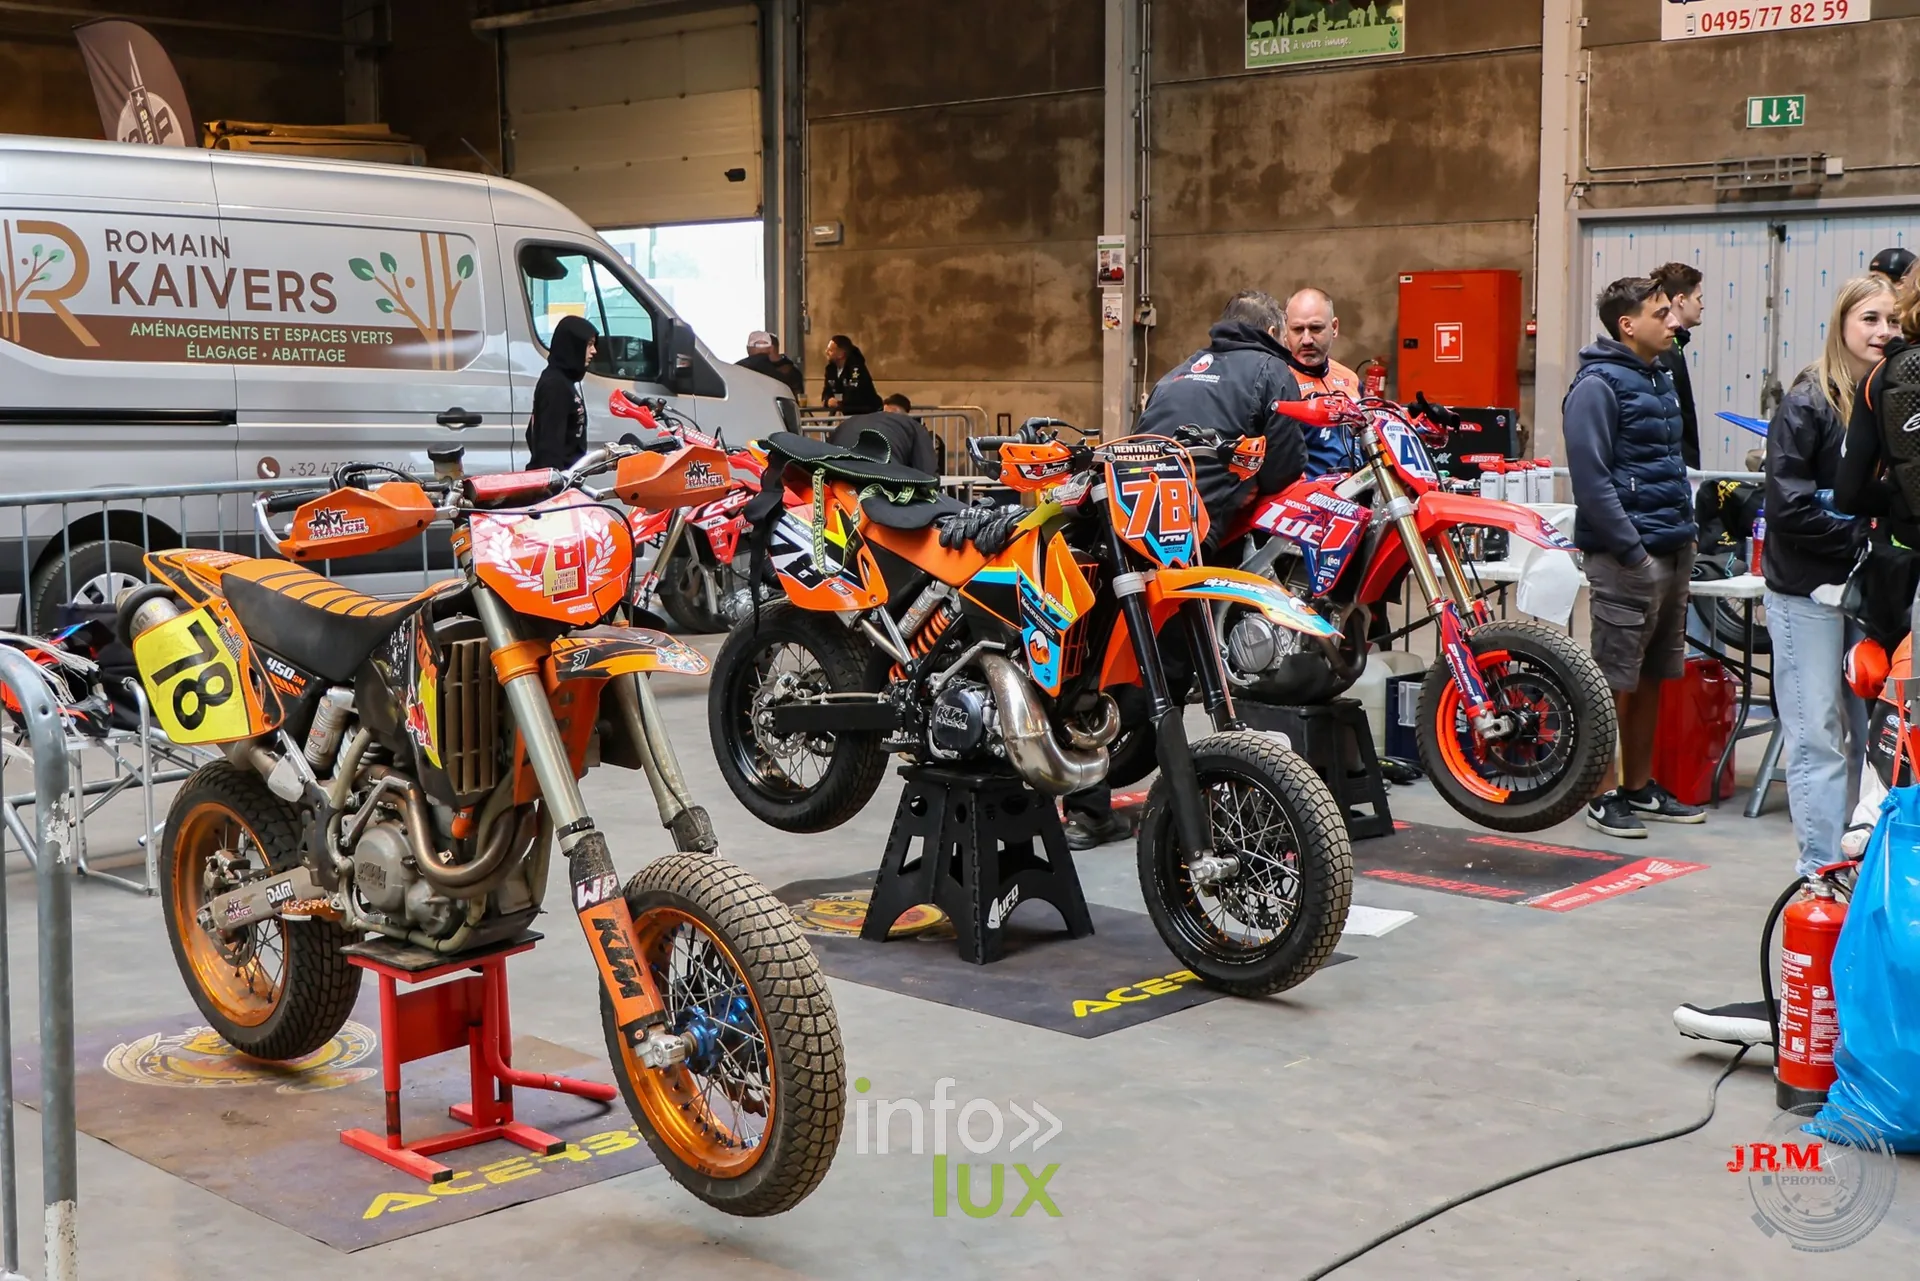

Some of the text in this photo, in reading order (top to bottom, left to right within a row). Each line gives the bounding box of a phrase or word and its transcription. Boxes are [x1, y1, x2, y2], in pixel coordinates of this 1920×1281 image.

[1701, 0, 1849, 32] 0495/77 82 59
[1250, 38, 1291, 57] SCAR
[1301, 38, 1321, 49] votre
[105, 228, 231, 259] ROMAIN
[108, 260, 337, 314] KAIVERS
[130, 320, 394, 345] AMÉNAGEMENTS ET ESPACES VERTS
[186, 340, 346, 363] ÉLAGAGE ABATTAGE
[1113, 444, 1159, 454] RENTHAL
[290, 462, 316, 477] +32
[1122, 477, 1191, 539] 78
[1284, 499, 1312, 514] HONDA
[150, 619, 234, 731] 78
[266, 656, 307, 687] 450 SM
[577, 873, 617, 909] WP
[999, 884, 1019, 916] UFO
[592, 918, 645, 999] KTM
